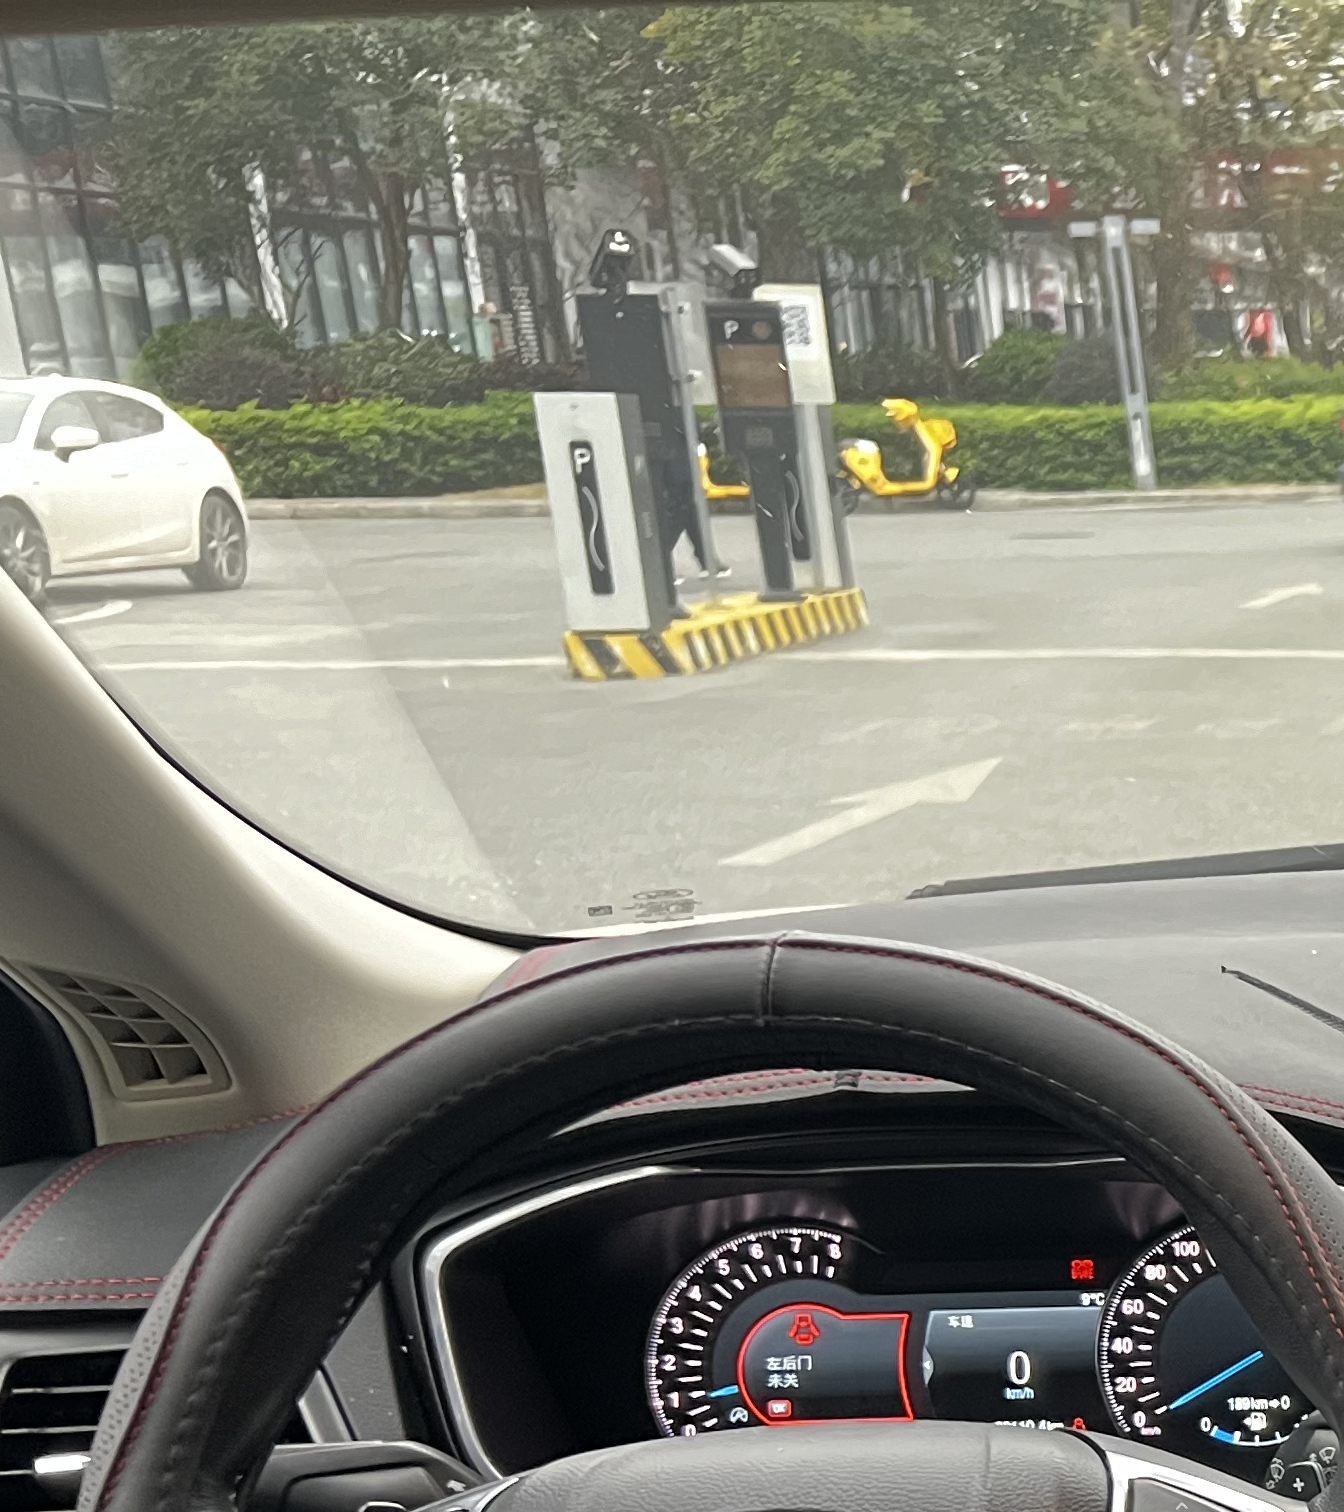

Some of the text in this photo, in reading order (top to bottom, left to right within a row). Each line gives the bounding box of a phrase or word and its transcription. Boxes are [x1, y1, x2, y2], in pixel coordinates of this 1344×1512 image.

[574, 447, 591, 474] P
[752, 1243, 764, 1259] 6
[790, 1237, 802, 1253] 7
[828, 1243, 842, 1259] 8
[1173, 1241, 1200, 1257] 100
[717, 1259, 730, 1275] 5
[1144, 1264, 1167, 1280] 80
[688, 1285, 701, 1301] 4
[1122, 1298, 1144, 1314] 60
[669, 1318, 684, 1334] 3
[1111, 1337, 1133, 1354] 40
[663, 1355, 676, 1371] 2
[766, 1355, 812, 1371] 左后门
[1007, 1351, 1030, 1384] 0
[767, 1374, 799, 1389] 未关
[1116, 1376, 1136, 1393] 20
[668, 1391, 680, 1408] 1
[1004, 1387, 1034, 1400] km/h
[1280, 1395, 1291, 1410] 0
[1133, 1410, 1146, 1428] 0
[1200, 1417, 1211, 1432] 0
